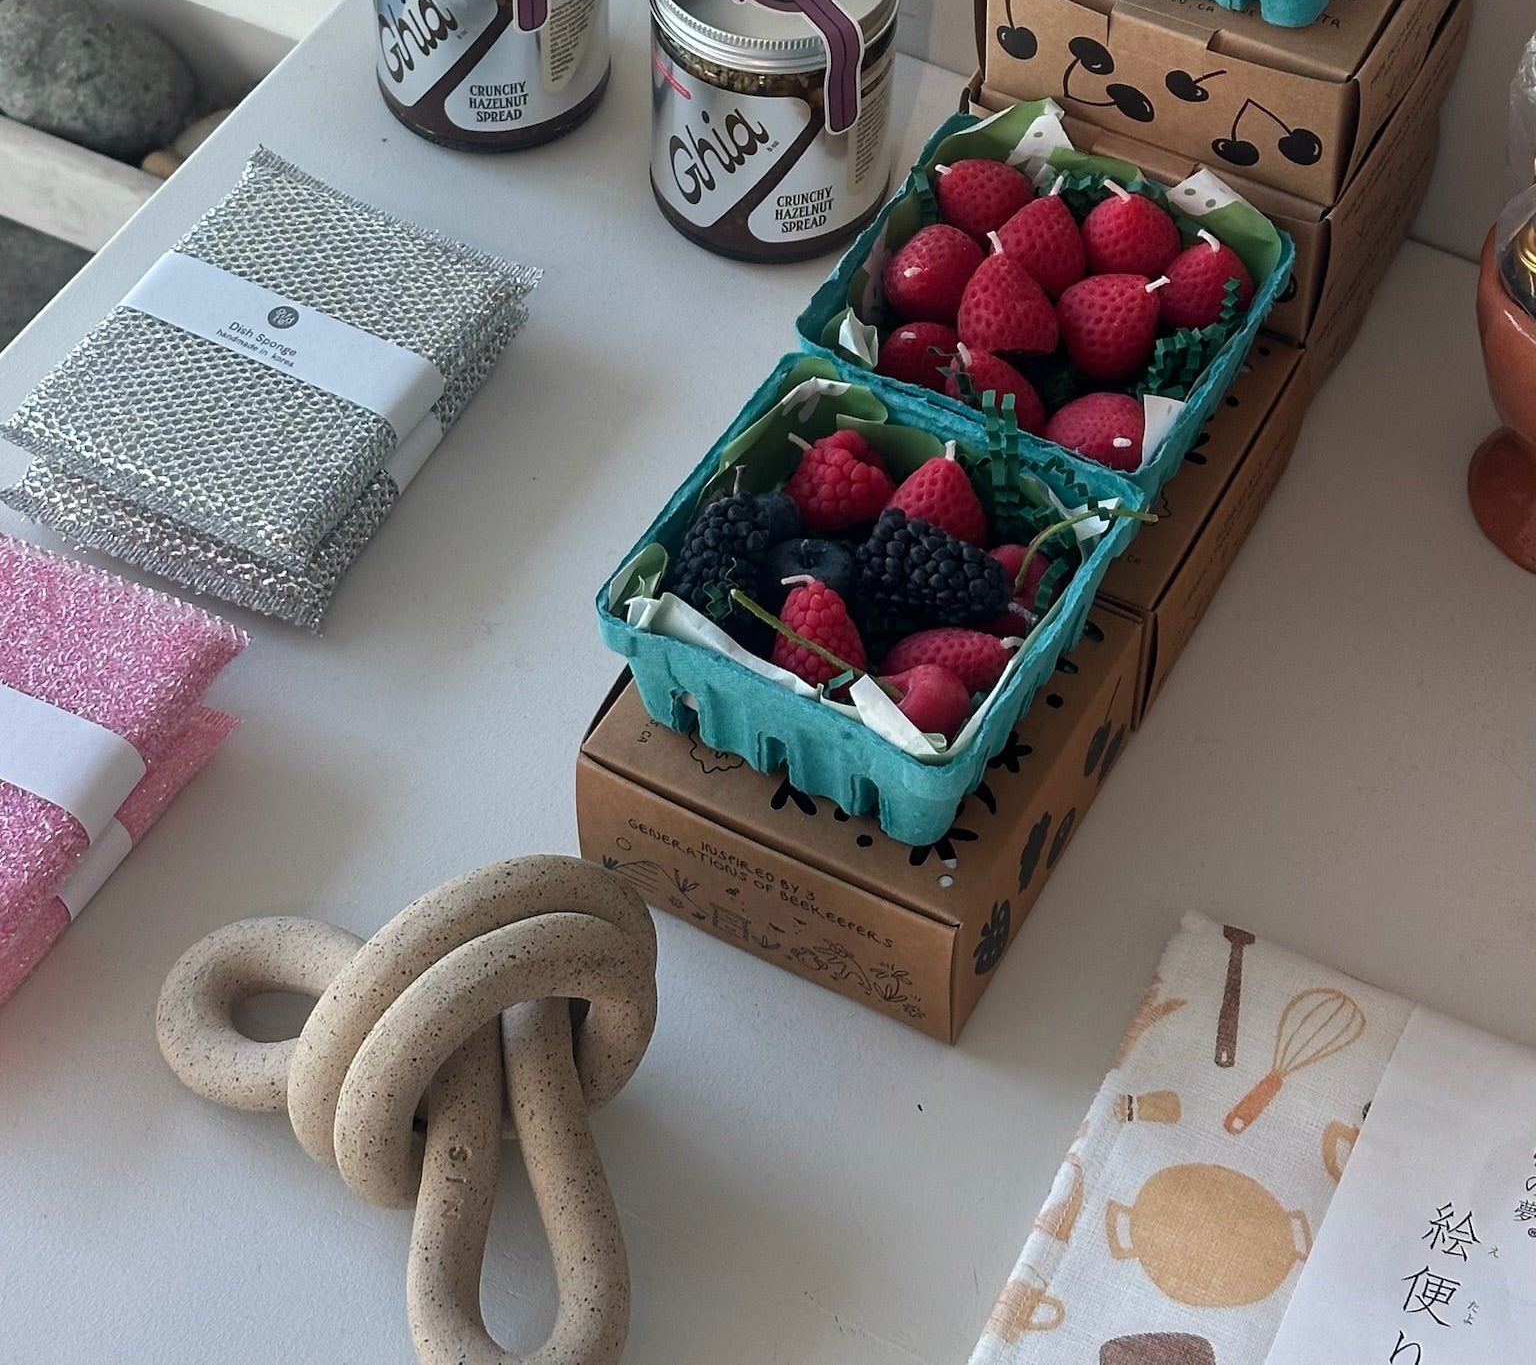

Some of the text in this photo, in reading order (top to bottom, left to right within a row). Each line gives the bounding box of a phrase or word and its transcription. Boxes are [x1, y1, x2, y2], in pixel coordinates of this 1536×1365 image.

[1197, 2, 1215, 14] CA
[469, 80, 527, 97] CRUNCHY
[468, 92, 529, 110] HAZELNUT
[476, 108, 523, 123] SPREAD
[669, 108, 769, 204] Ghia
[776, 185, 833, 208] CRUNCHY
[775, 198, 834, 221] HAZELNUT
[781, 215, 827, 234] SPREAD
[216, 328, 259, 352] handmade
[258, 348, 268, 356] in
[228, 321, 297, 357] Dish Sponge
[700, 840, 816, 901] INSPIRED BY 3
[628, 818, 894, 949] GENERATIONS OF BEEKEEPERS
[1389, 1202, 1482, 1365] 絵便り
